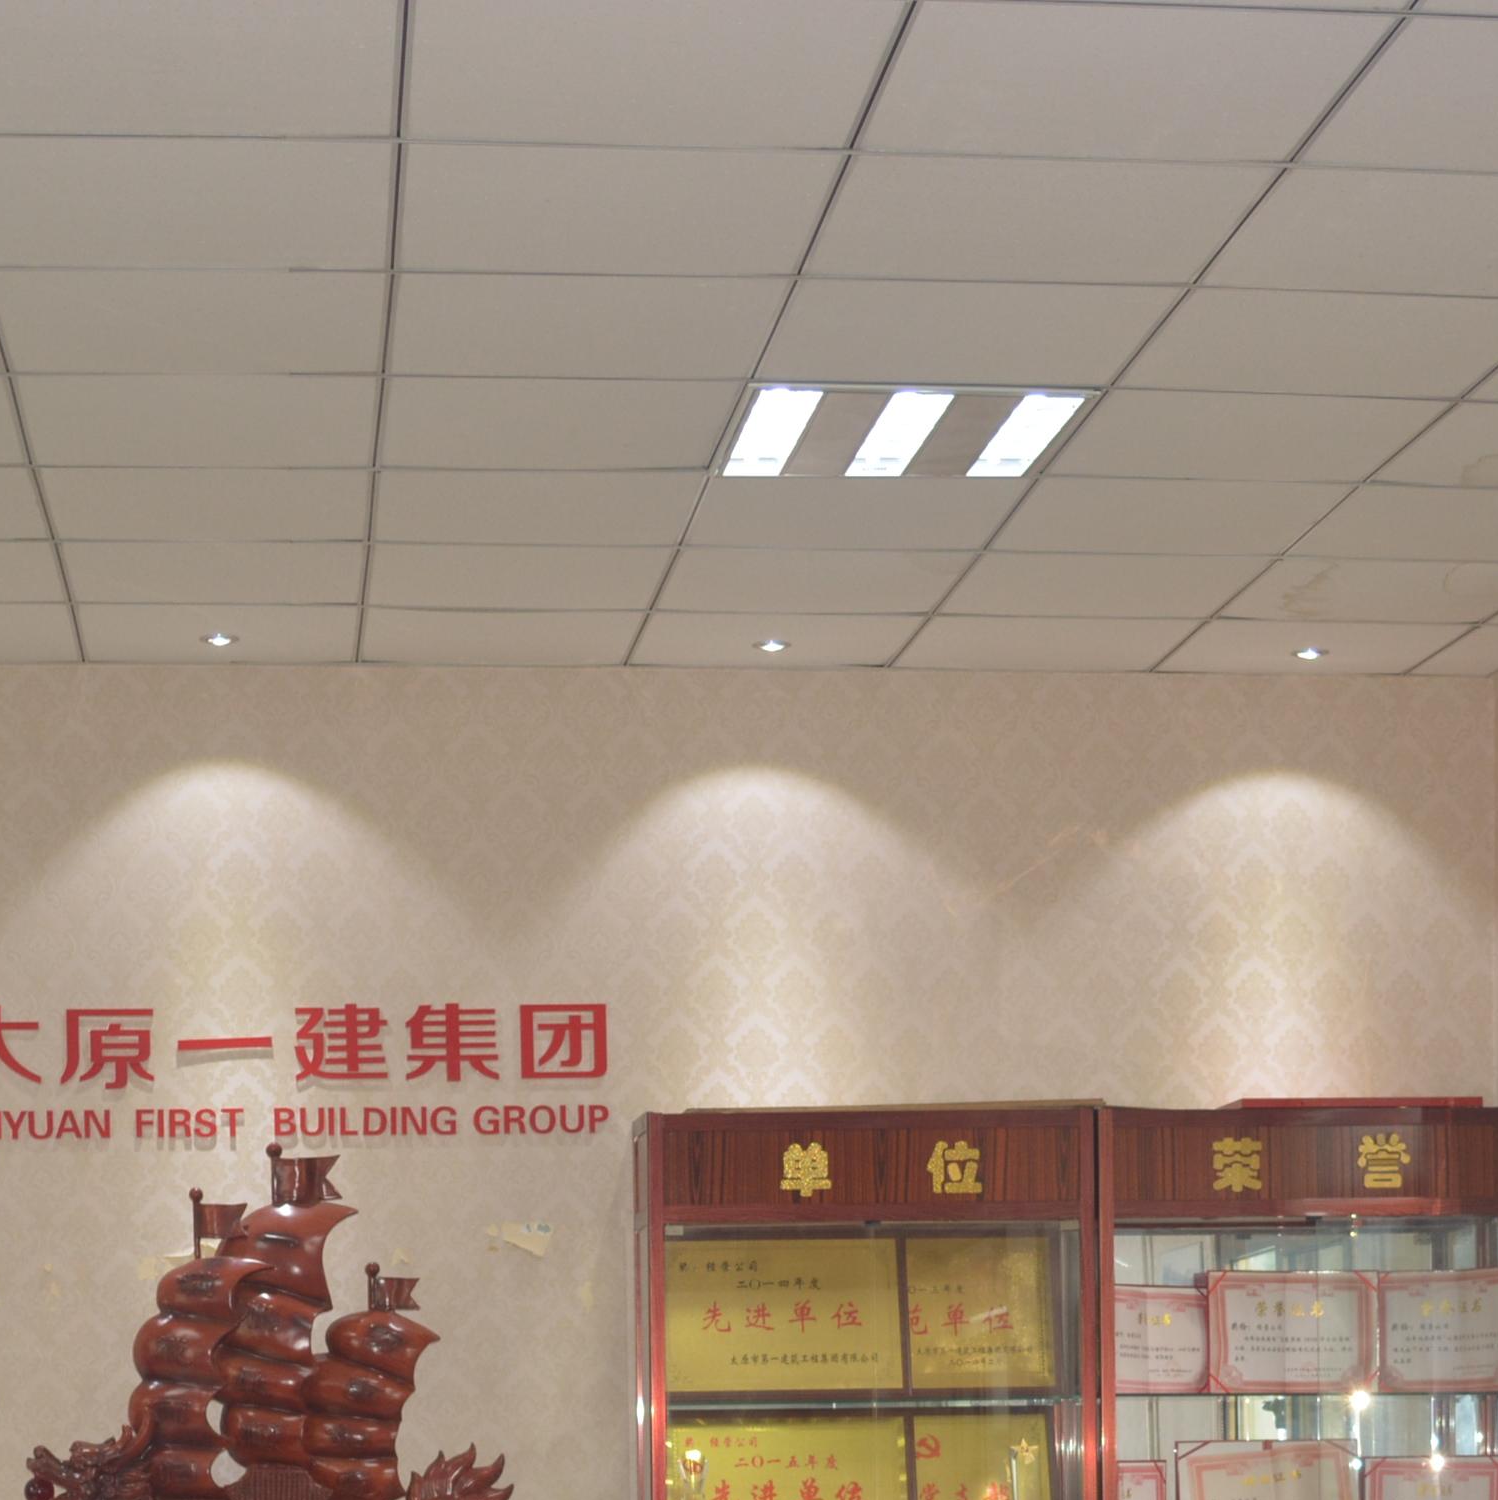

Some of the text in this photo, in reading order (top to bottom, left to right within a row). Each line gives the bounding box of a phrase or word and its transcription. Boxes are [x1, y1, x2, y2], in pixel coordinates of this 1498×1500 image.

[135, 1107, 245, 1140] FIRST
[273, 1105, 458, 1138] BUILDING
[472, 1103, 609, 1137] GROUP
[779, 1133, 1411, 1196] 单位 荣誉
[702, 1299, 863, 1334] 先进单位
